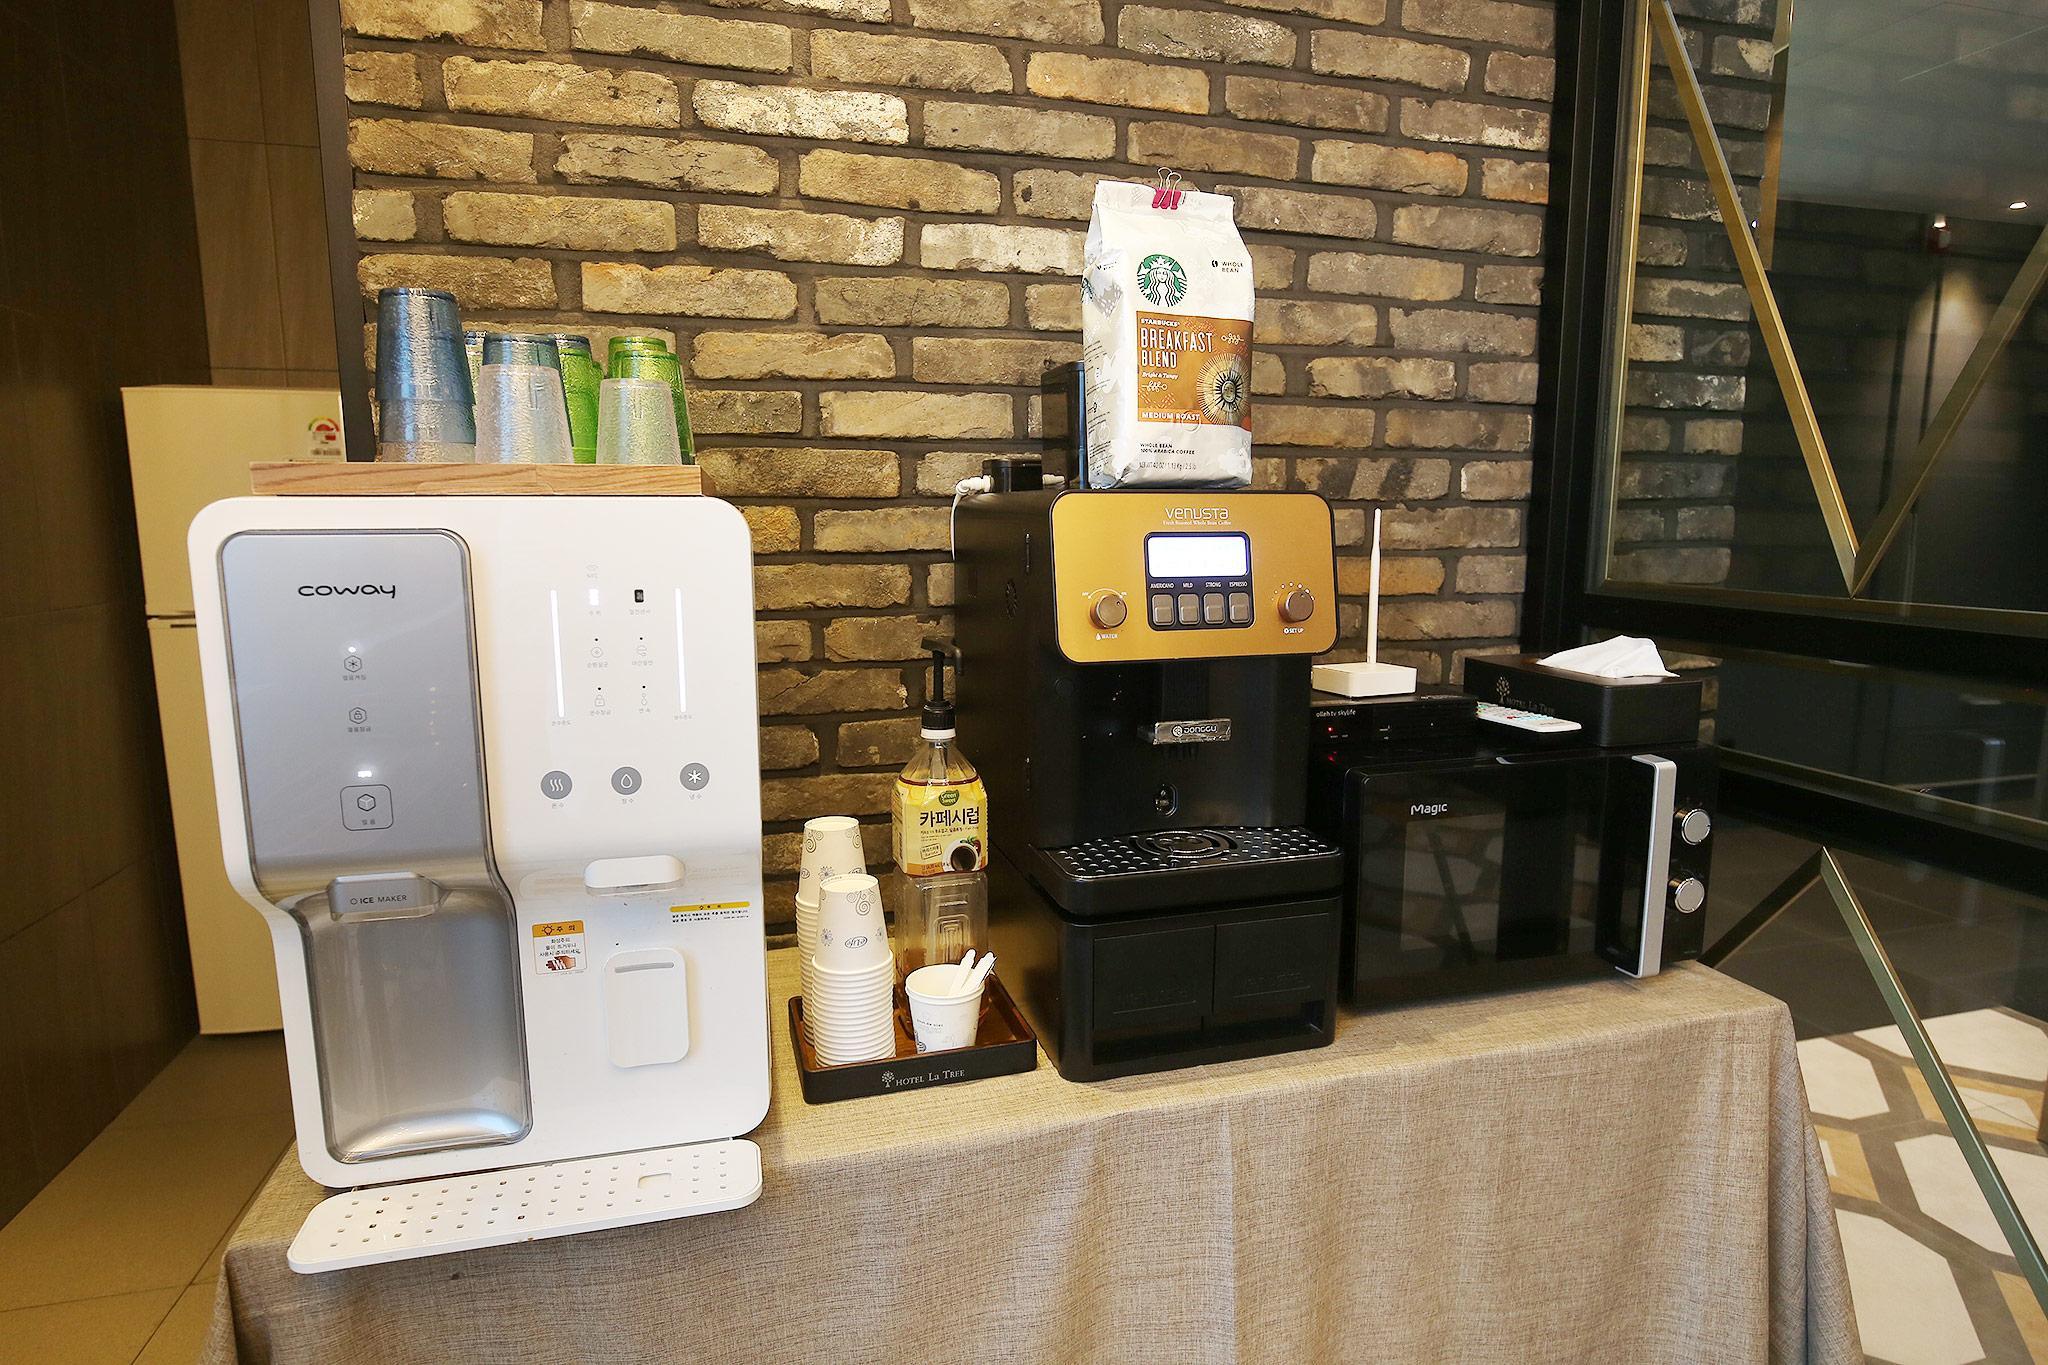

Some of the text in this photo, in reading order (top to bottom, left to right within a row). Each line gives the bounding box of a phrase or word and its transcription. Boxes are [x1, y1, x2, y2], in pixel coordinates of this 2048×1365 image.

[1140, 327, 1213, 353] BREAKFAST
[1141, 349, 1177, 368] BLEND
[1142, 411, 1200, 421] MEDIUM ROAST
[298, 585, 396, 599] coway
[919, 806, 980, 828] 카페시럽
[1410, 803, 1448, 816] Magic
[360, 894, 407, 905] ICE MAKER
[896, 1069, 965, 1086] HOTEL La TREE
